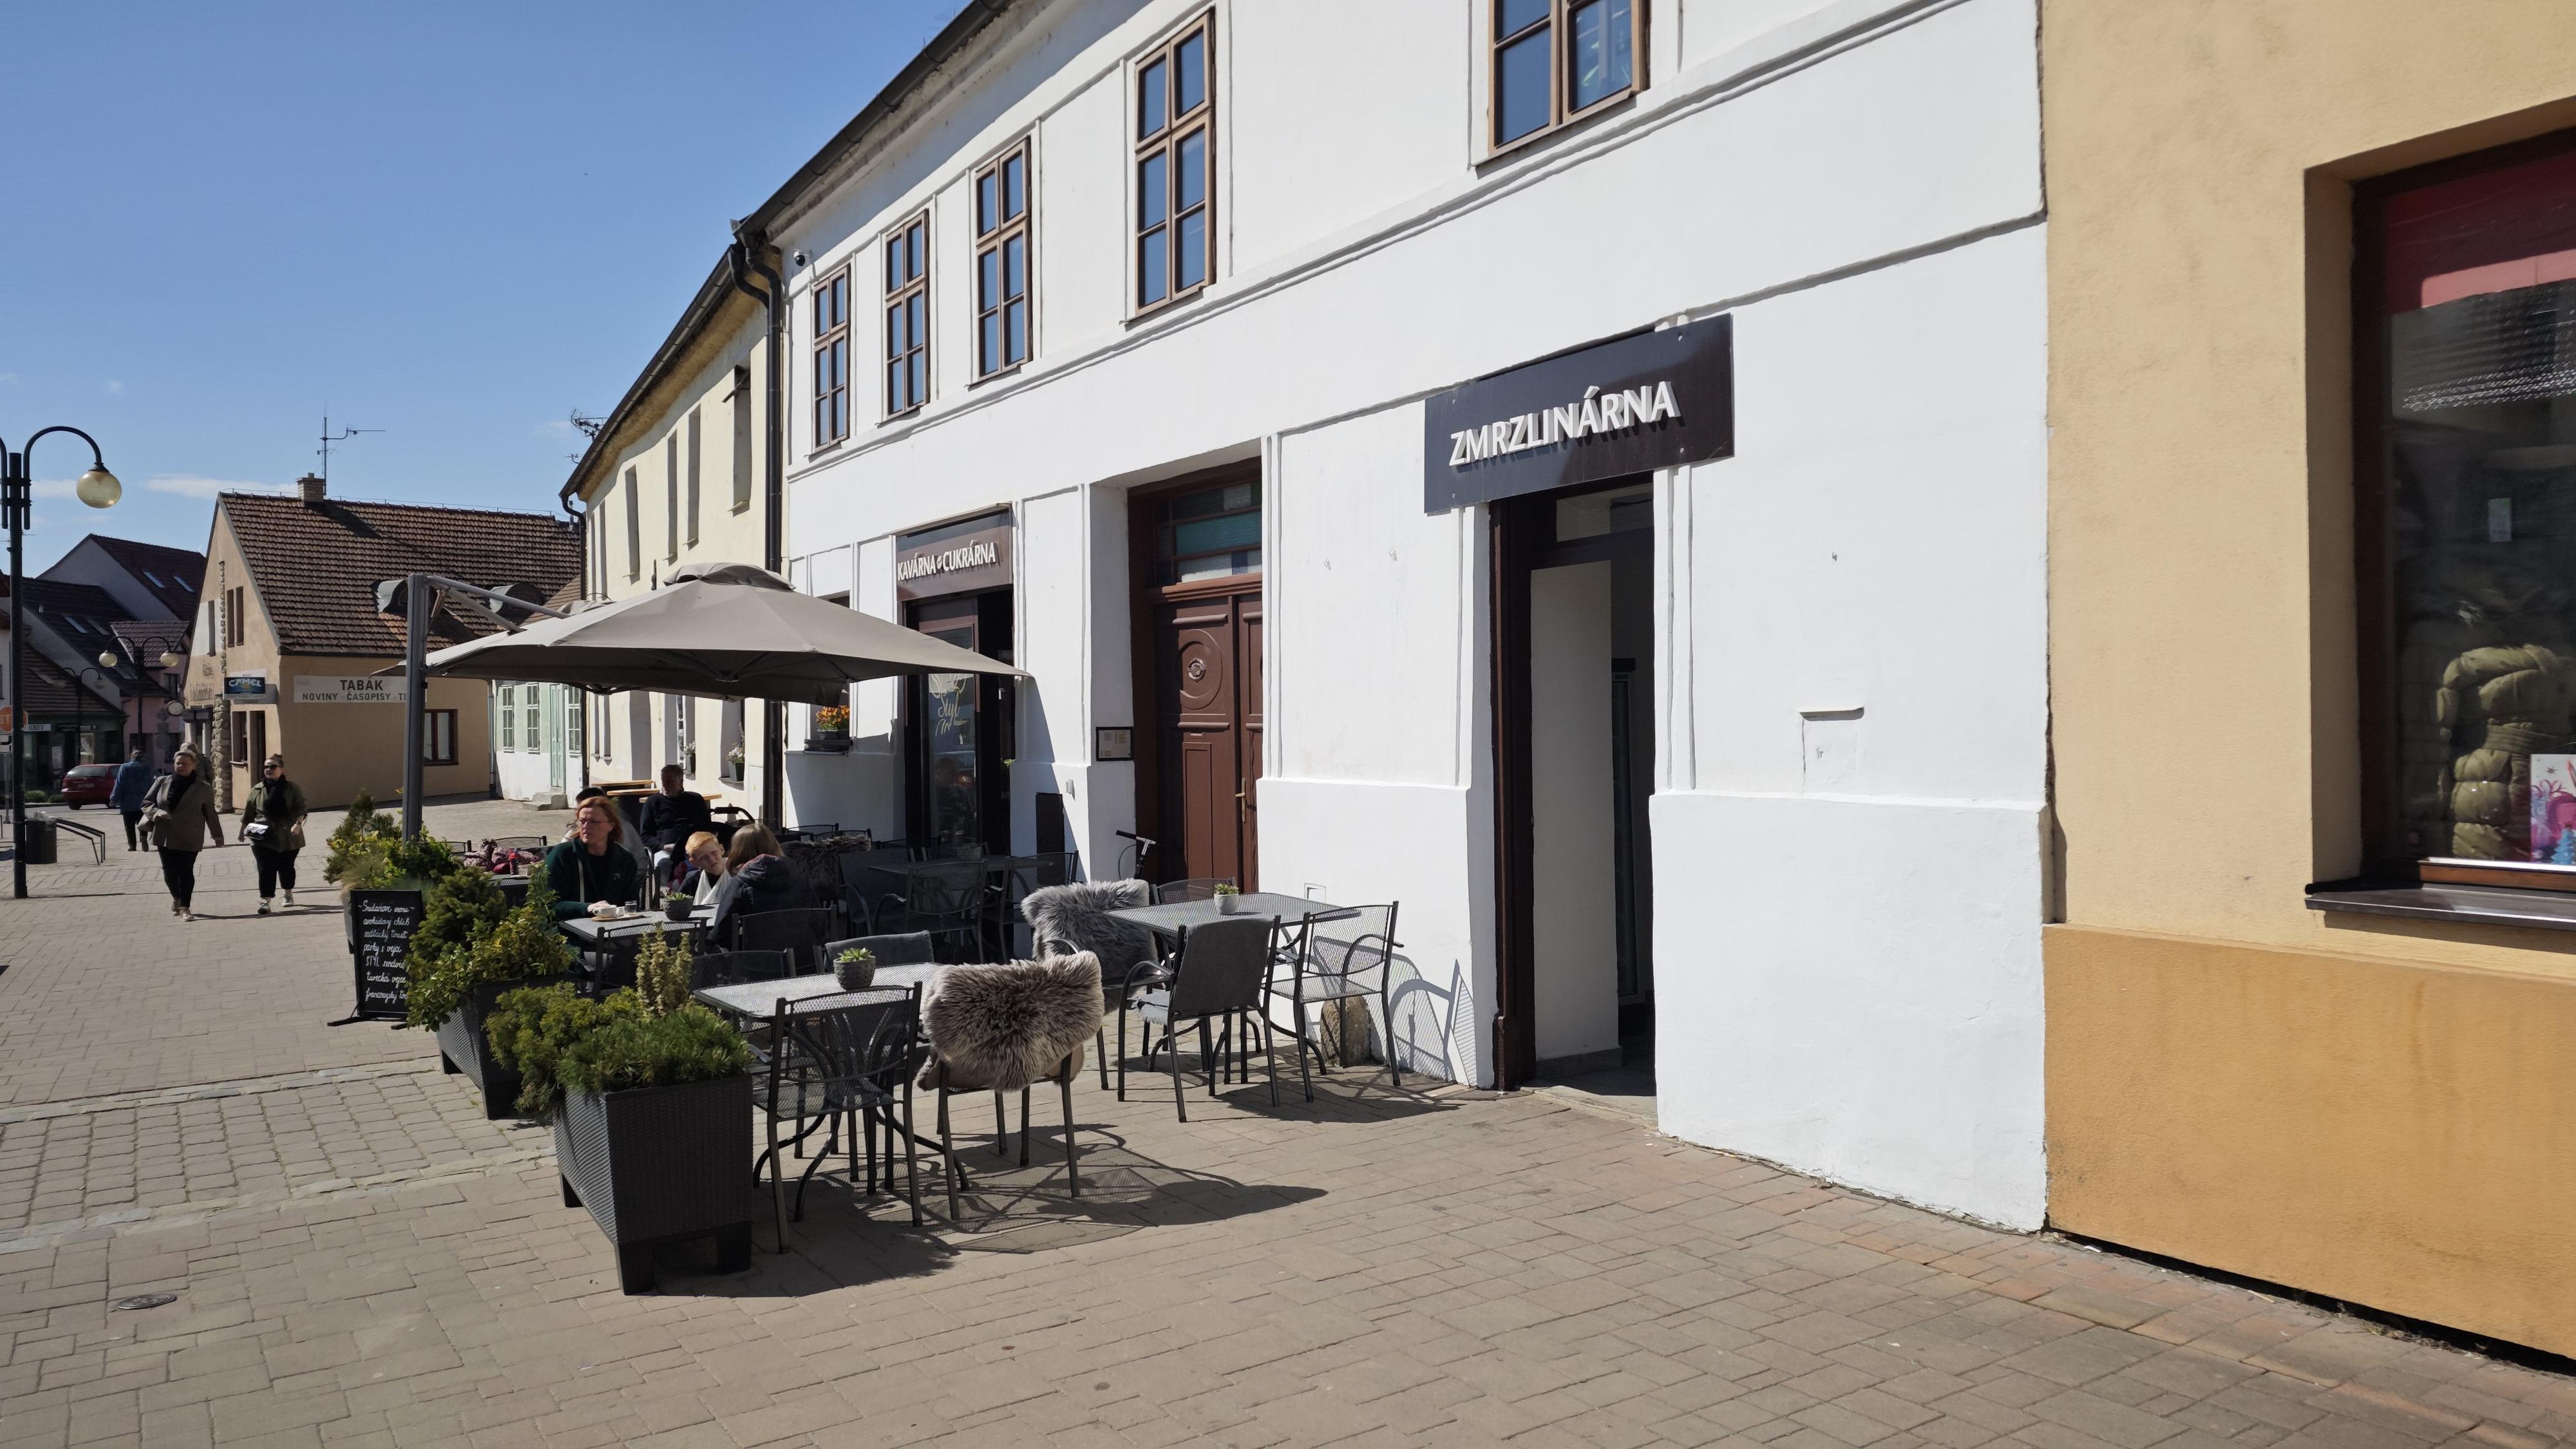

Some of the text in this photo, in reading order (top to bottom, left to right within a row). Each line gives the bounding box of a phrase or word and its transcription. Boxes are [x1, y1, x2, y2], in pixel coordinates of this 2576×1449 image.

[1449, 381, 1680, 467] ZMRZLINÁRNA
[898, 540, 996, 581] KAVÁRNA CUKRÁRNA
[229, 678, 262, 687] CAMEL
[339, 677, 384, 691] TABÁK
[346, 691, 391, 701] ČASOPISY
[938, 688, 960, 727] Styl
[365, 956, 379, 967] STYL
